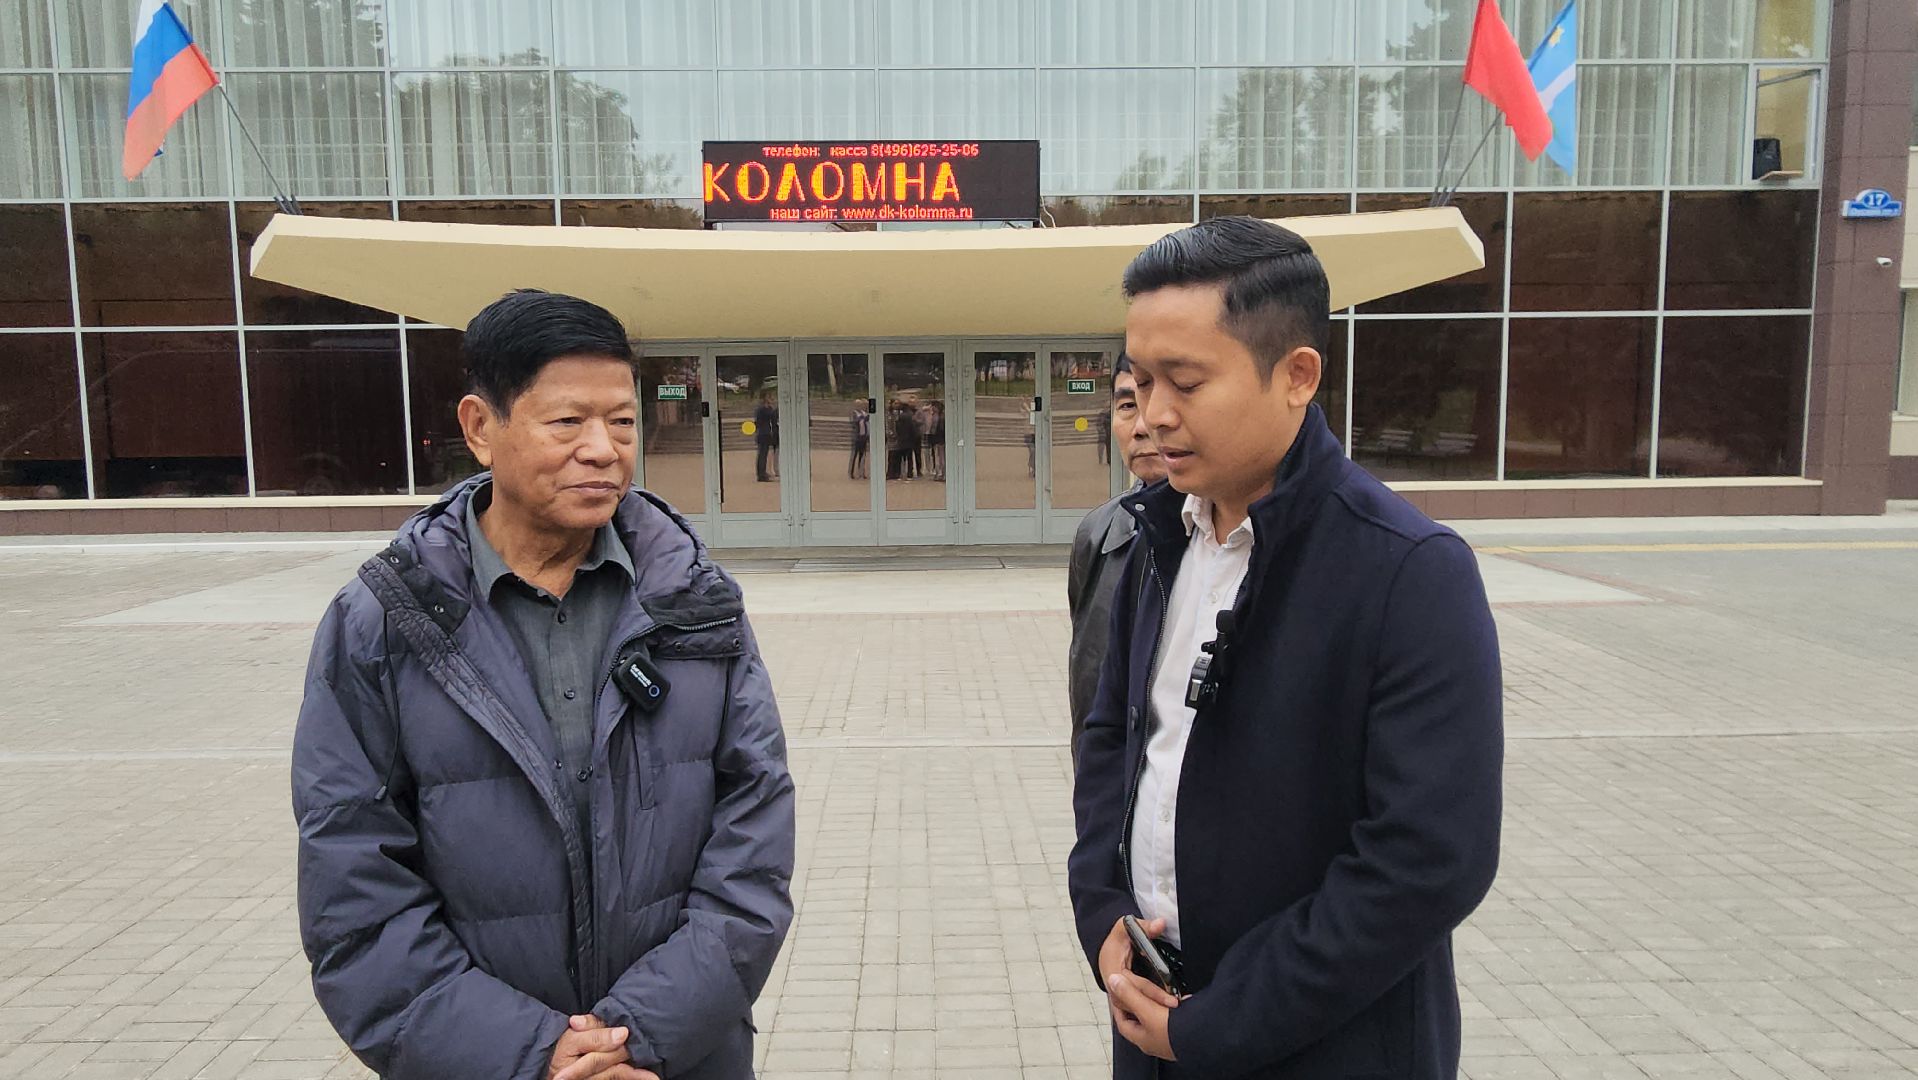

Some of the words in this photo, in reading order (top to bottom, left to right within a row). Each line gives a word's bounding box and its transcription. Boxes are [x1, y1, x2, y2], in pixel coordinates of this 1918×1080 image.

[762, 144, 820, 158] телефон:
[829, 146, 868, 157] касса
[871, 143, 979, 158] 8(496)625-25-06
[704, 161, 960, 202] КОЛОМНА
[1868, 192, 1886, 206] 17
[770, 208, 800, 220] наш
[841, 204, 973, 220] www.dk-kolomna.ru
[659, 387, 686, 397] ВЫХОД
[1072, 382, 1091, 391] ВХОД
